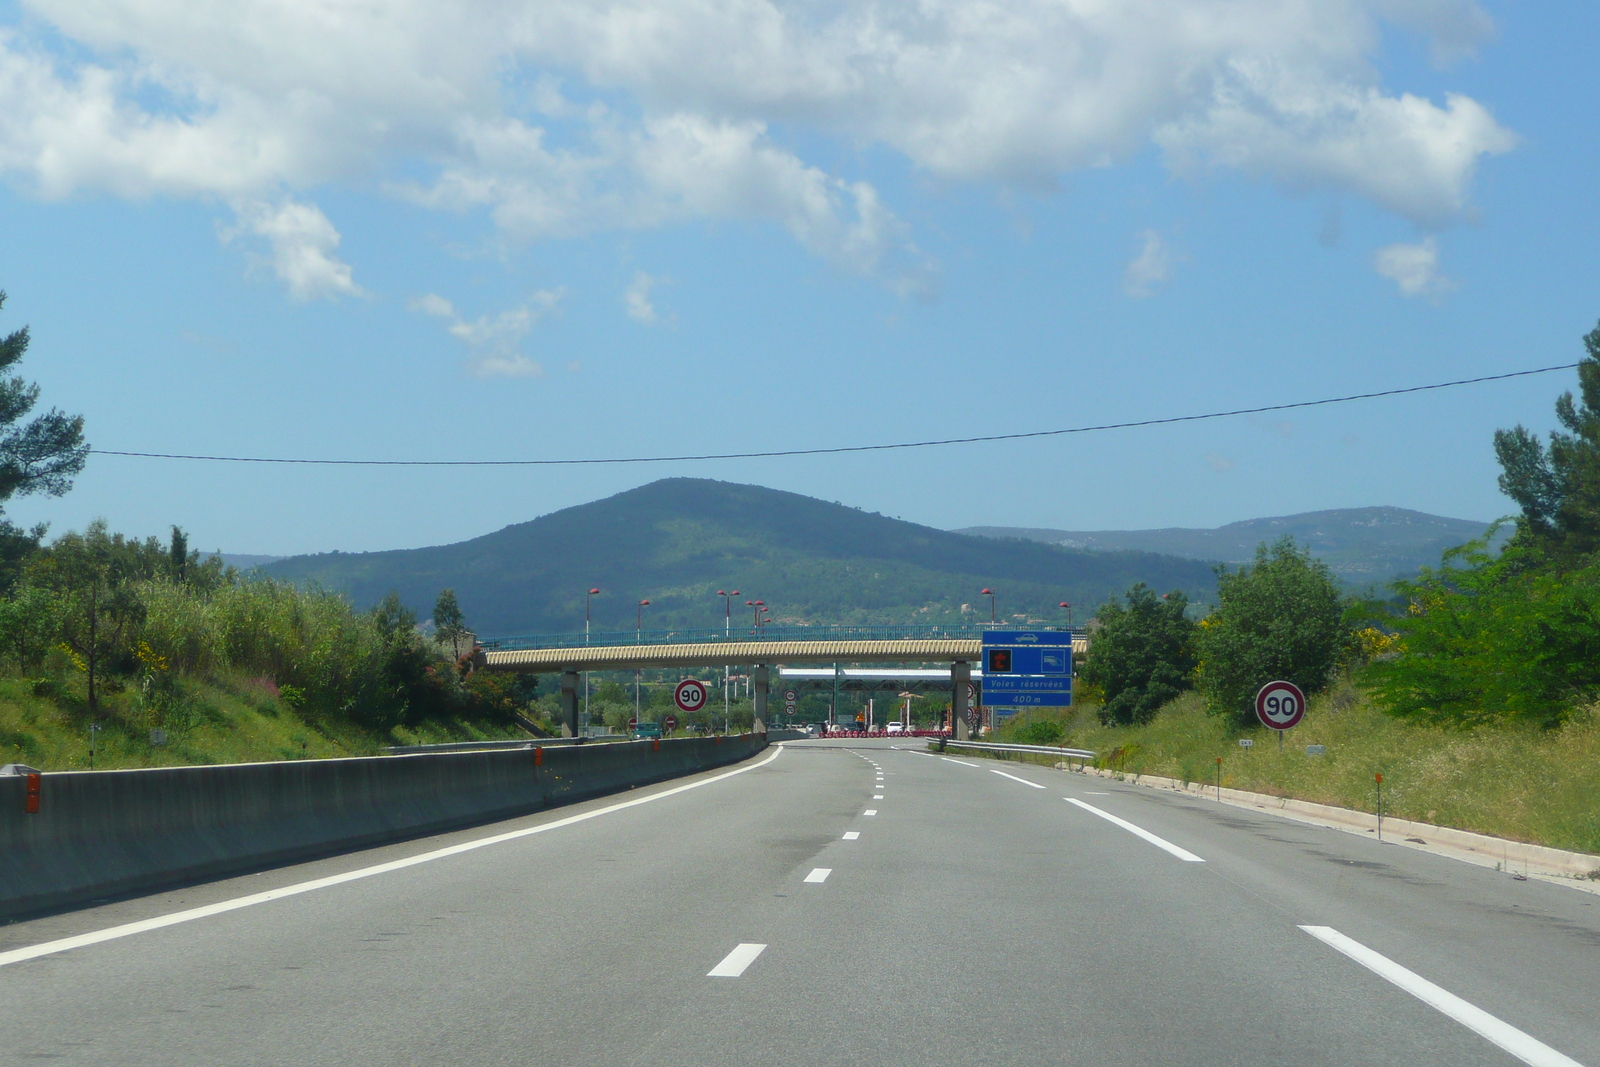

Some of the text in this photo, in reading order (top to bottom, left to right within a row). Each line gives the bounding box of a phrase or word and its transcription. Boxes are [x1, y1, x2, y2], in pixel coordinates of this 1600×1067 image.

[991, 679, 1064, 688] Voies réservées
[681, 689, 700, 702] 90
[1013, 695, 1032, 703] 400
[1266, 696, 1295, 716] 90
